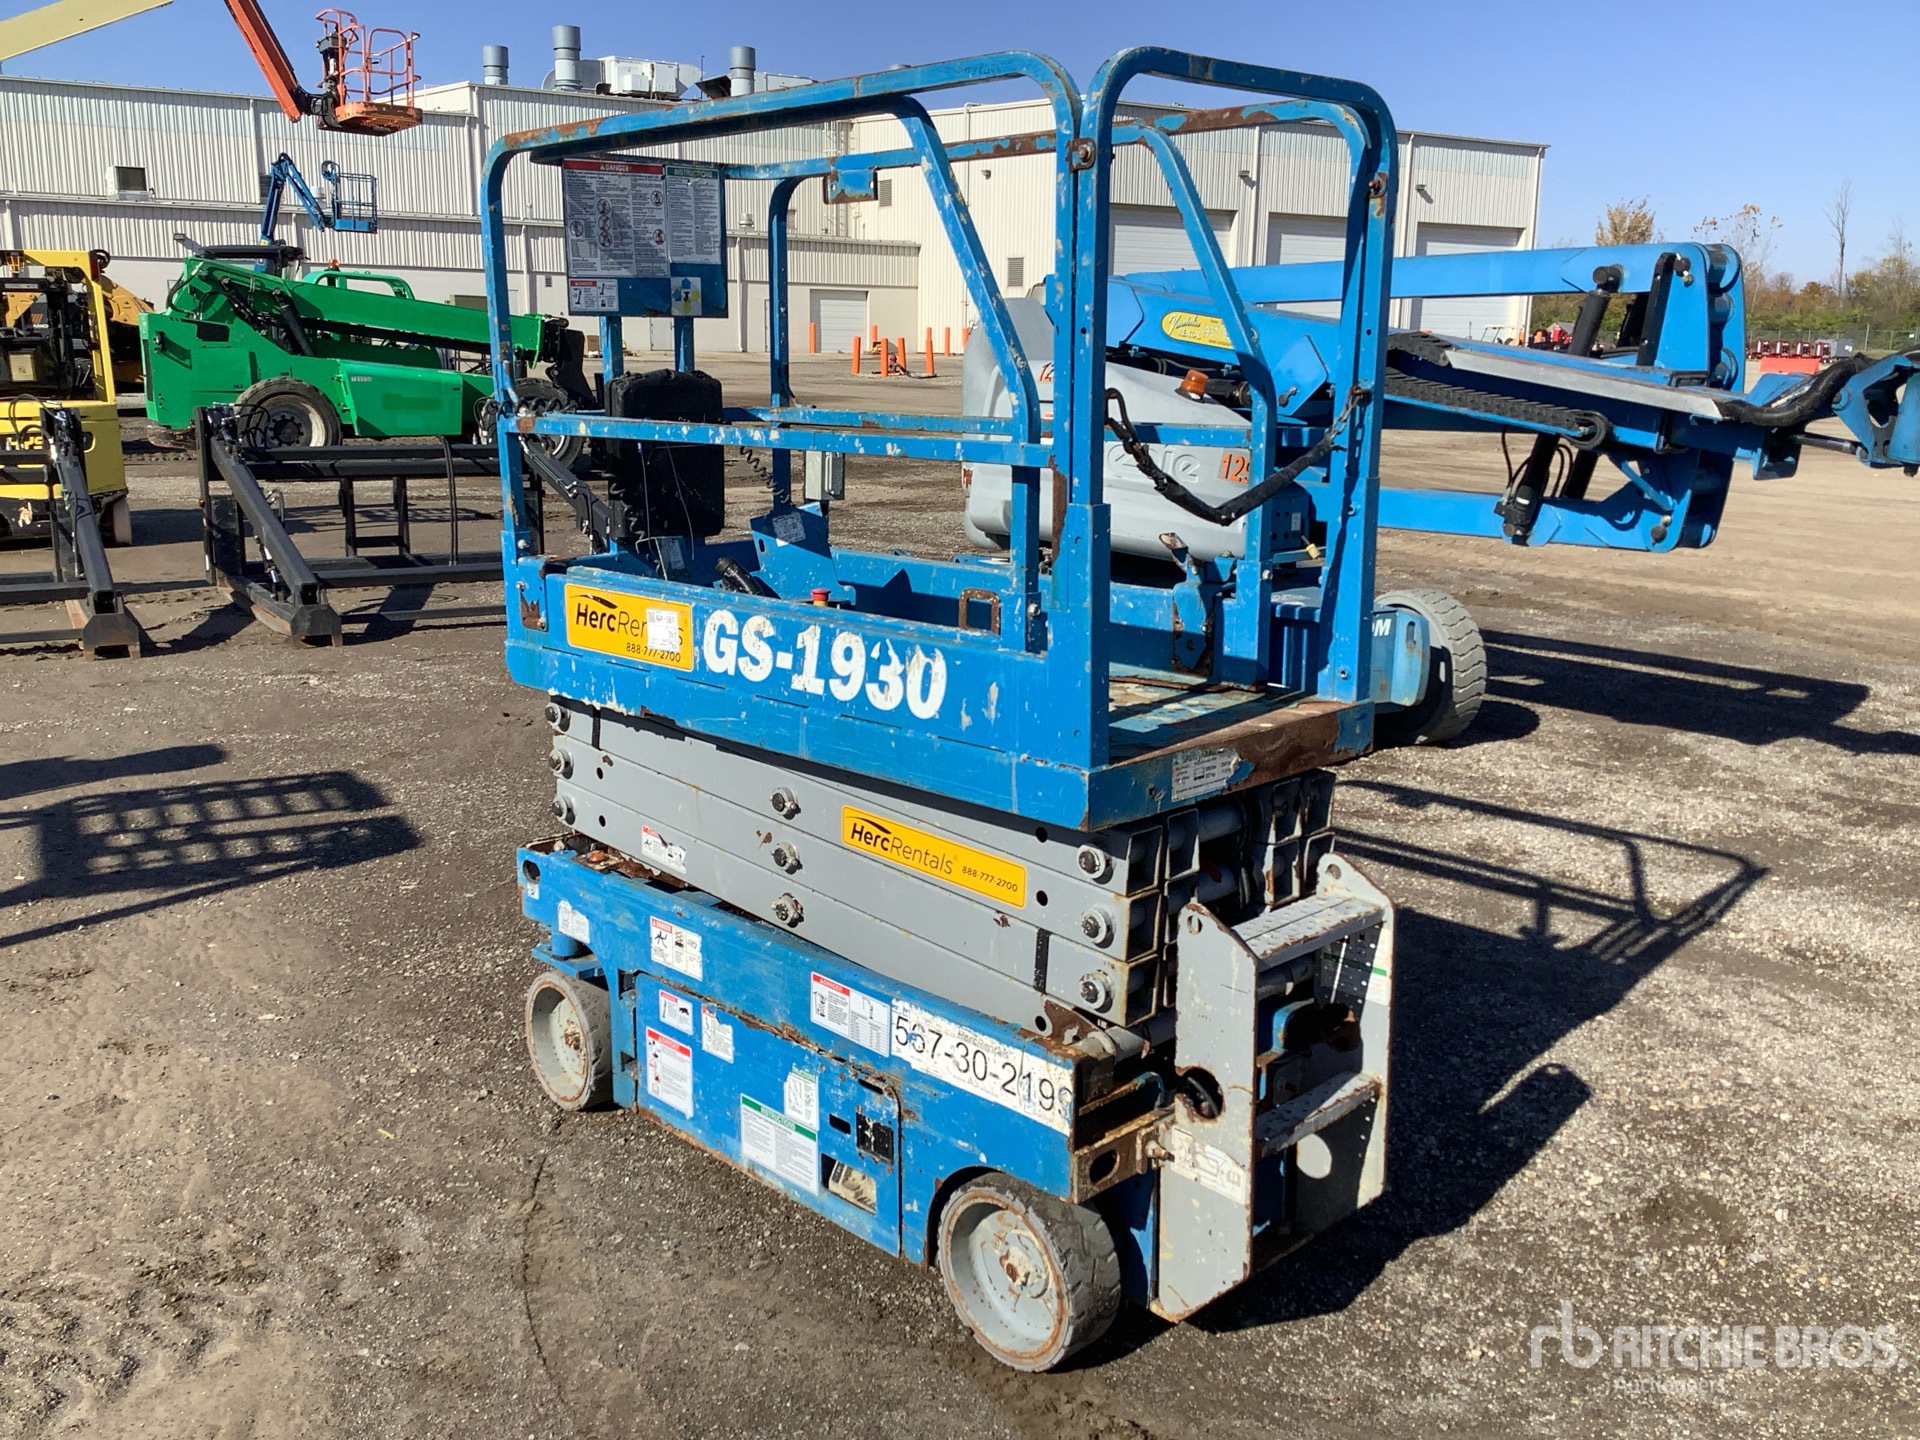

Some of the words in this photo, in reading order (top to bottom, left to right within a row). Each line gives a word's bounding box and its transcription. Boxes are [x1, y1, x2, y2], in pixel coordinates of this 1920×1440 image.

[626, 642, 681, 663] 888-777-2700
[703, 609, 948, 720] GS-1930
[851, 822, 953, 875] HercRentals
[961, 865, 1018, 892] 888-777-2700
